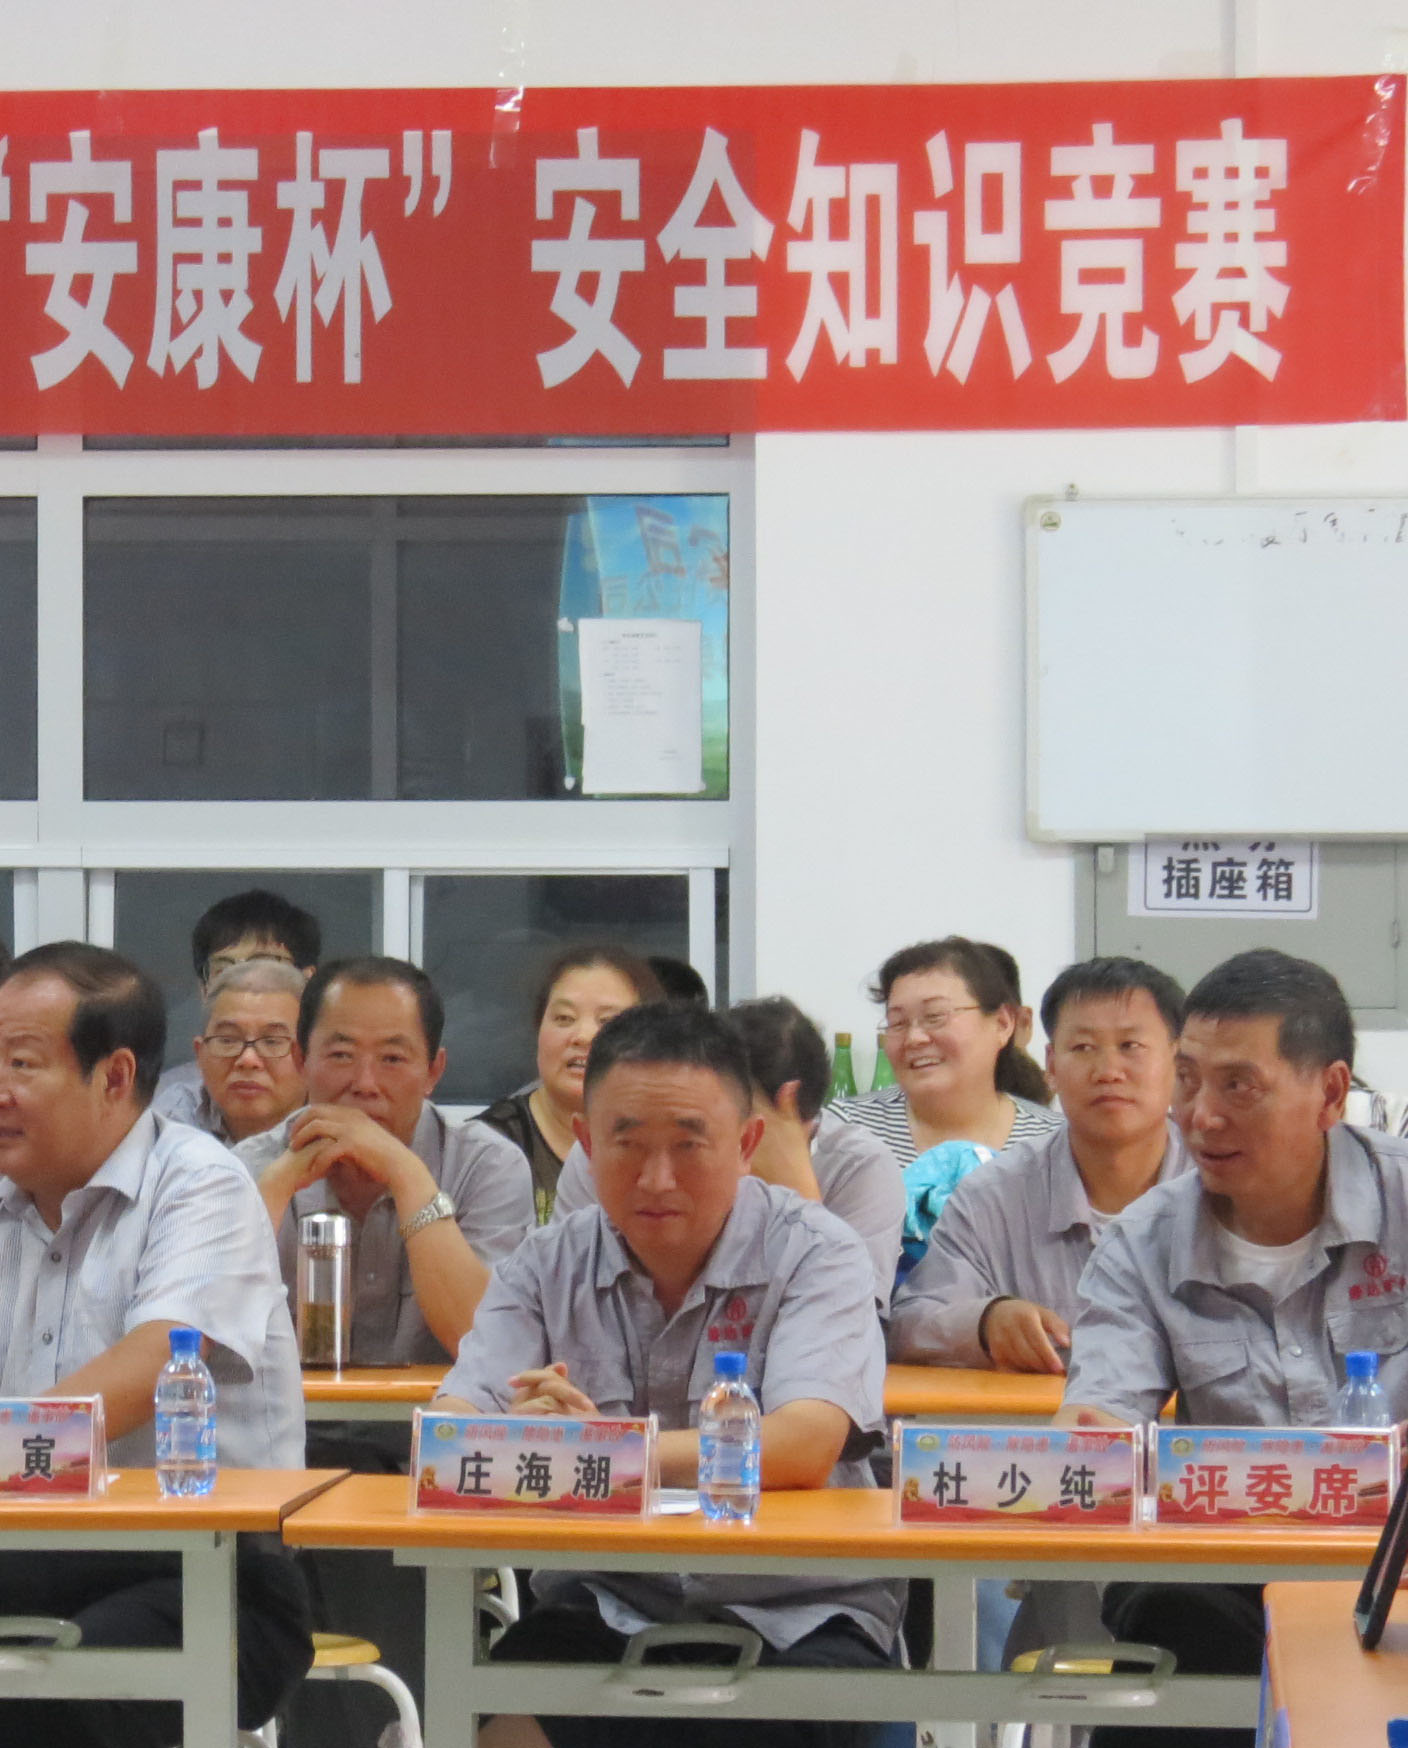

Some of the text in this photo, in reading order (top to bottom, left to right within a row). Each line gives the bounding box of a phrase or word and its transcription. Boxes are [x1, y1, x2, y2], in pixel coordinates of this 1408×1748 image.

[1162, 856, 1295, 901] 插座箱
[456, 1451, 611, 1498] 庄海潮
[933, 1461, 1096, 1509] 杜少纯
[1178, 1463, 1358, 1516] 评委席
